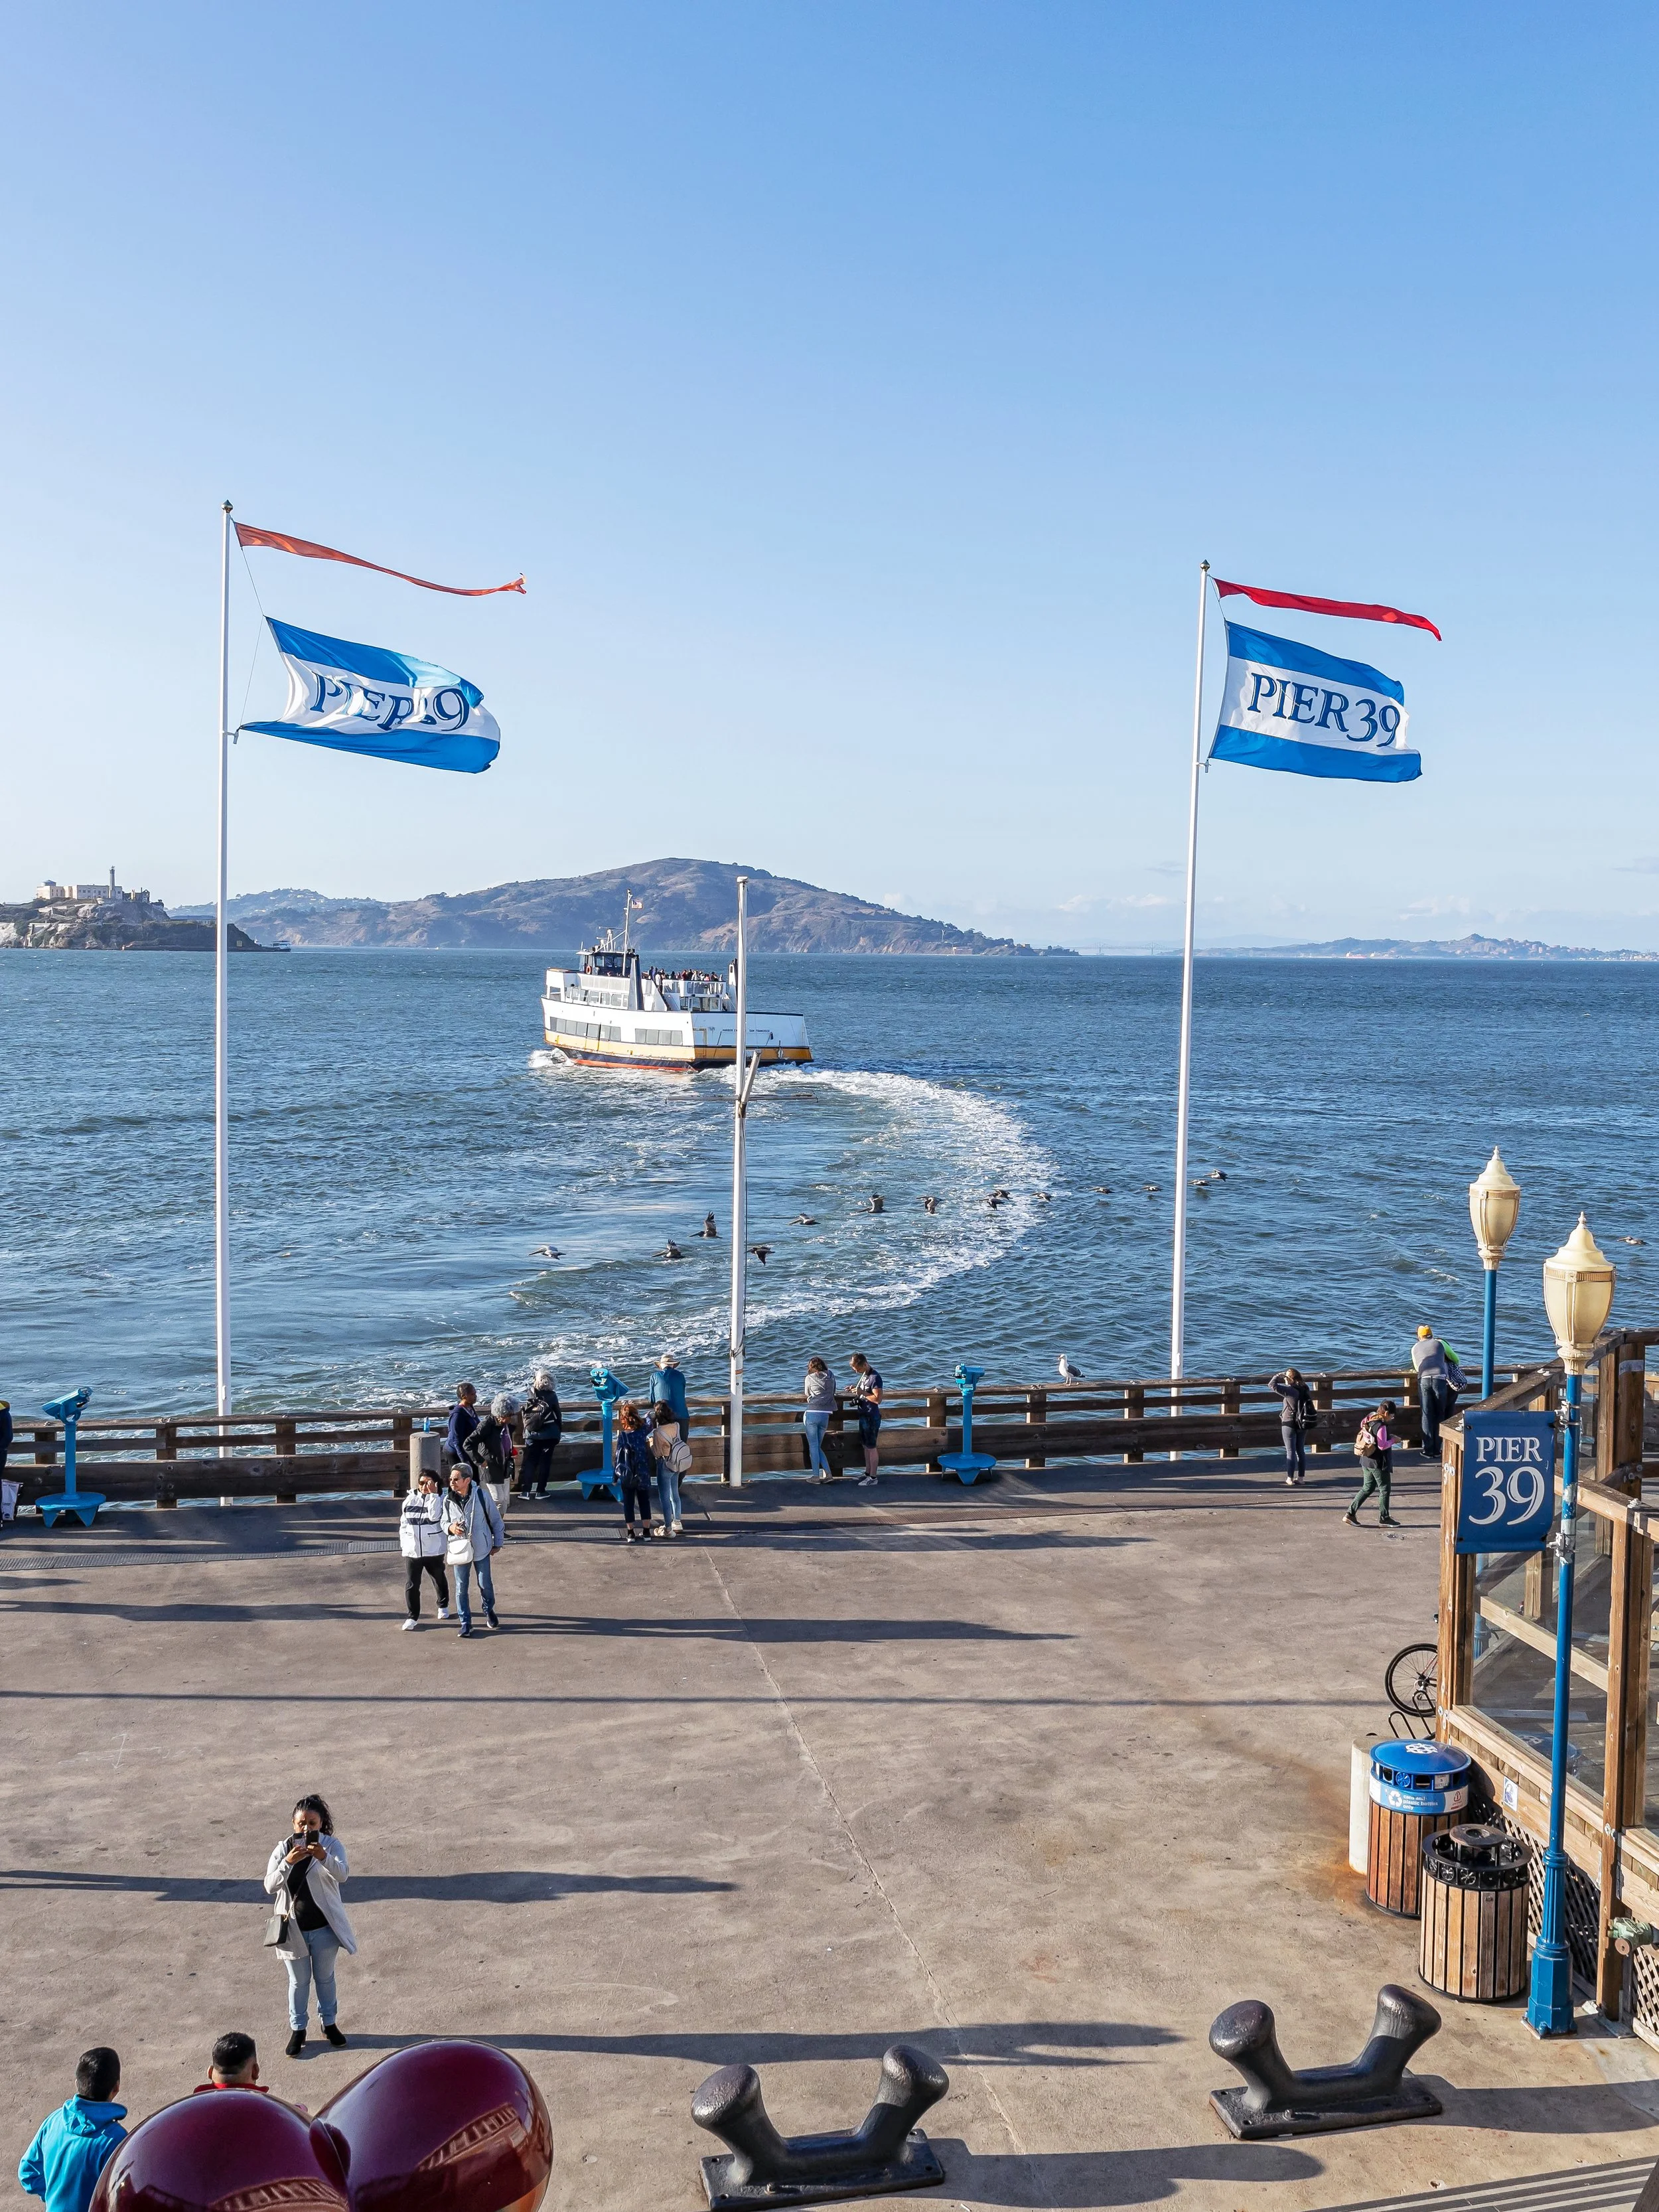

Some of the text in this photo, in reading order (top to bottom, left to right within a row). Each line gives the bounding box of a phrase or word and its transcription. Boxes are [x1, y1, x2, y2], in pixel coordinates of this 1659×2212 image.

[1247, 672, 1401, 747] PIER 39
[1475, 1437, 1543, 1462] PIER
[1468, 1466, 1545, 1525] 39
